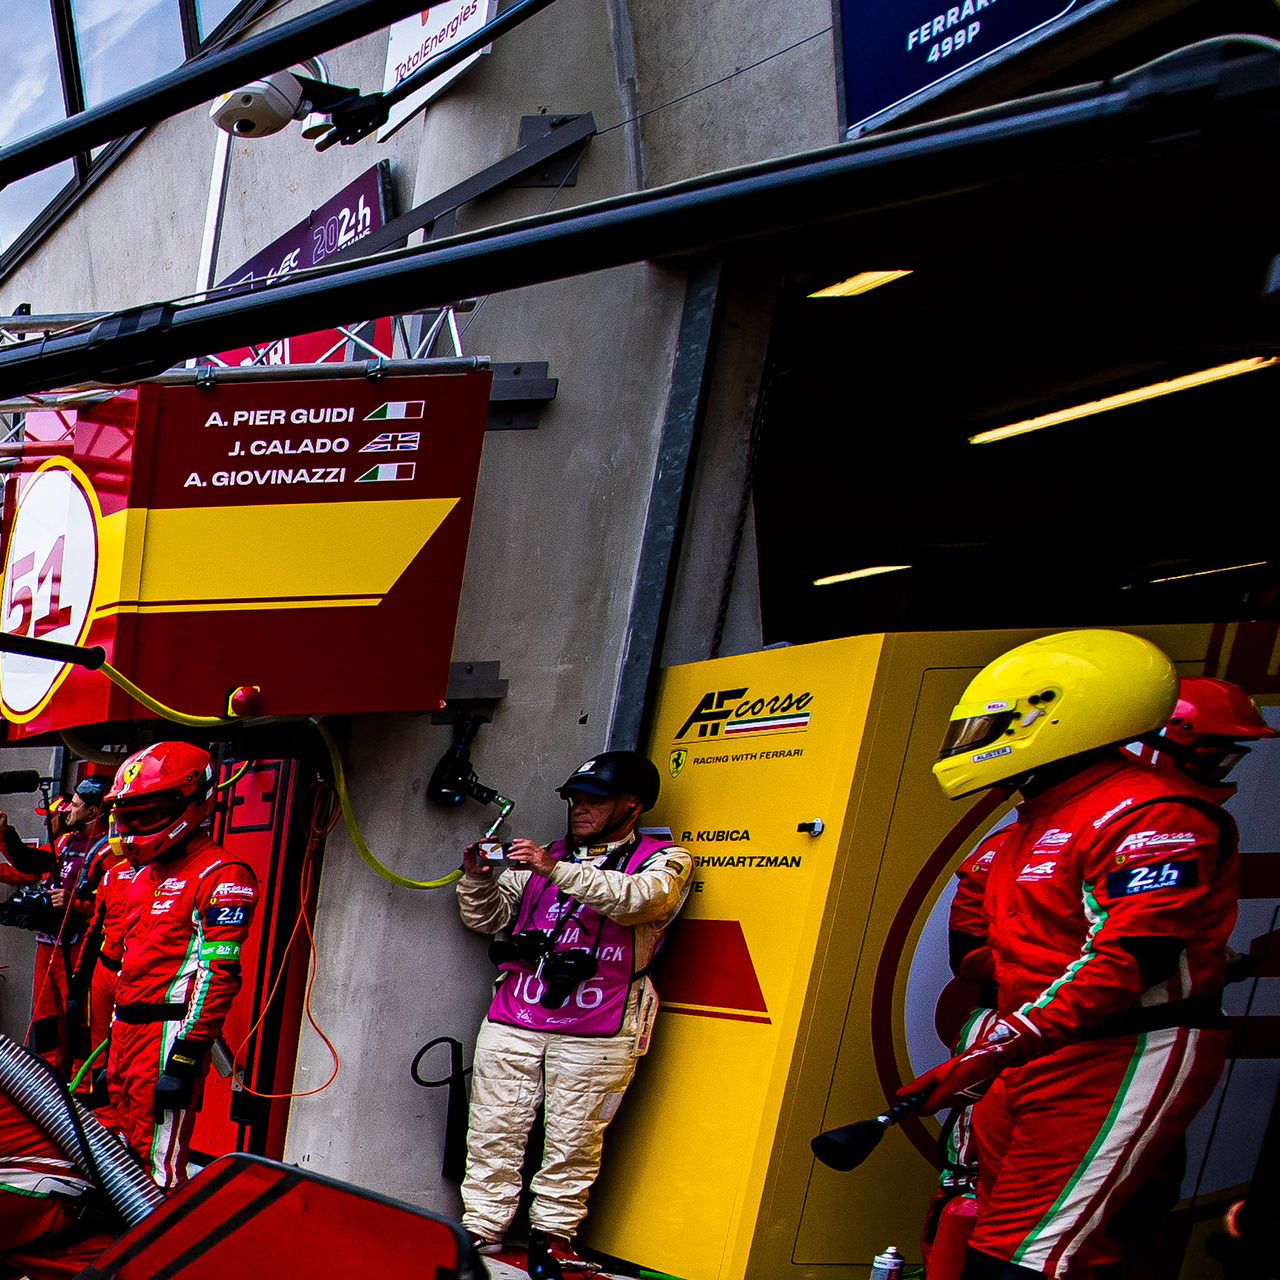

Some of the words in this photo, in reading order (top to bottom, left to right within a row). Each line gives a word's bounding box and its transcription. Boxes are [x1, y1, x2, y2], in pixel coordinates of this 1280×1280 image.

[394, 0, 478, 82] TotalEnergies
[927, 21, 981, 63] 499P
[205, 412, 228, 427] A.
[233, 410, 287, 426] PIER
[290, 407, 355, 425] GUIDI
[228, 441, 245, 456] J.
[250, 437, 350, 456] CALADO
[184, 472, 207, 488] A.
[212, 467, 347, 486] GIOVINAZZI
[7, 534, 72, 637] 51
[734, 692, 814, 718] corse
[693, 754, 729, 766] RACING
[731, 751, 757, 763] WITH
[759, 748, 804, 760] FERRARI
[681, 831, 693, 843] R.
[696, 829, 751, 842] KUBICA
[692, 855, 802, 868] SHWARTZMAN
[1143, 880, 1177, 890] MANS
